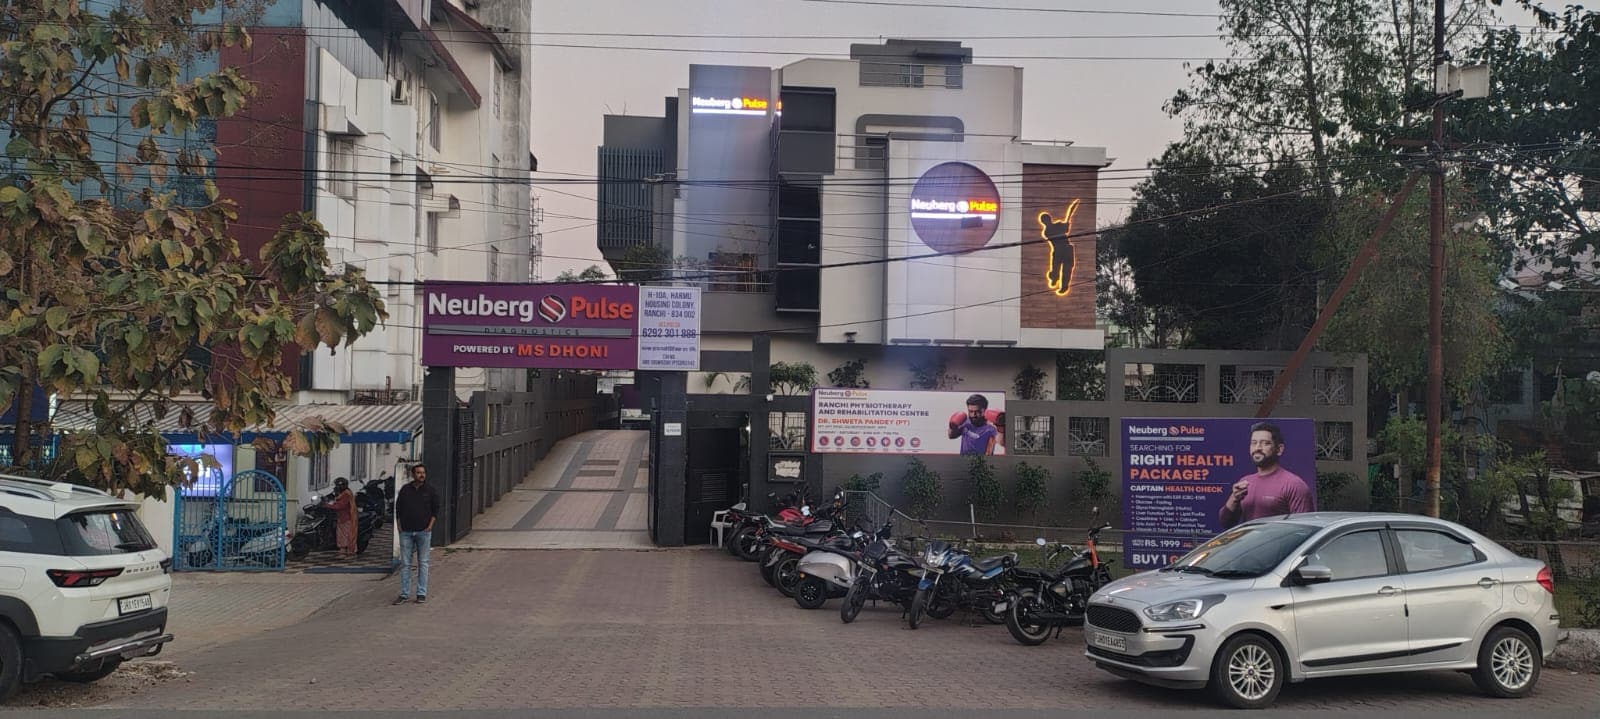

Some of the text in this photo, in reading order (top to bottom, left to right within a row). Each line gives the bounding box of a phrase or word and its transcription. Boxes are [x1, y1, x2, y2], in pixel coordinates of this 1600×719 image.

[692, 96, 768, 109] Neuberg Pulse
[912, 198, 997, 212] Neuberg Pulse
[428, 293, 633, 322] Neuberg Pulse
[484, 327, 580, 336] DIAGNOSTICS
[642, 328, 662, 337] 6292
[664, 329, 678, 338] 301
[454, 344, 608, 357] POWERED BY MS DHONI
[1129, 425, 1204, 436] Neuberg Pulse
[1130, 454, 1233, 466] RIGHT HEALTH
[1130, 468, 1209, 480] PACKAGE?
[1132, 554, 1160, 564] BUY
[1162, 555, 1167, 564] 1
